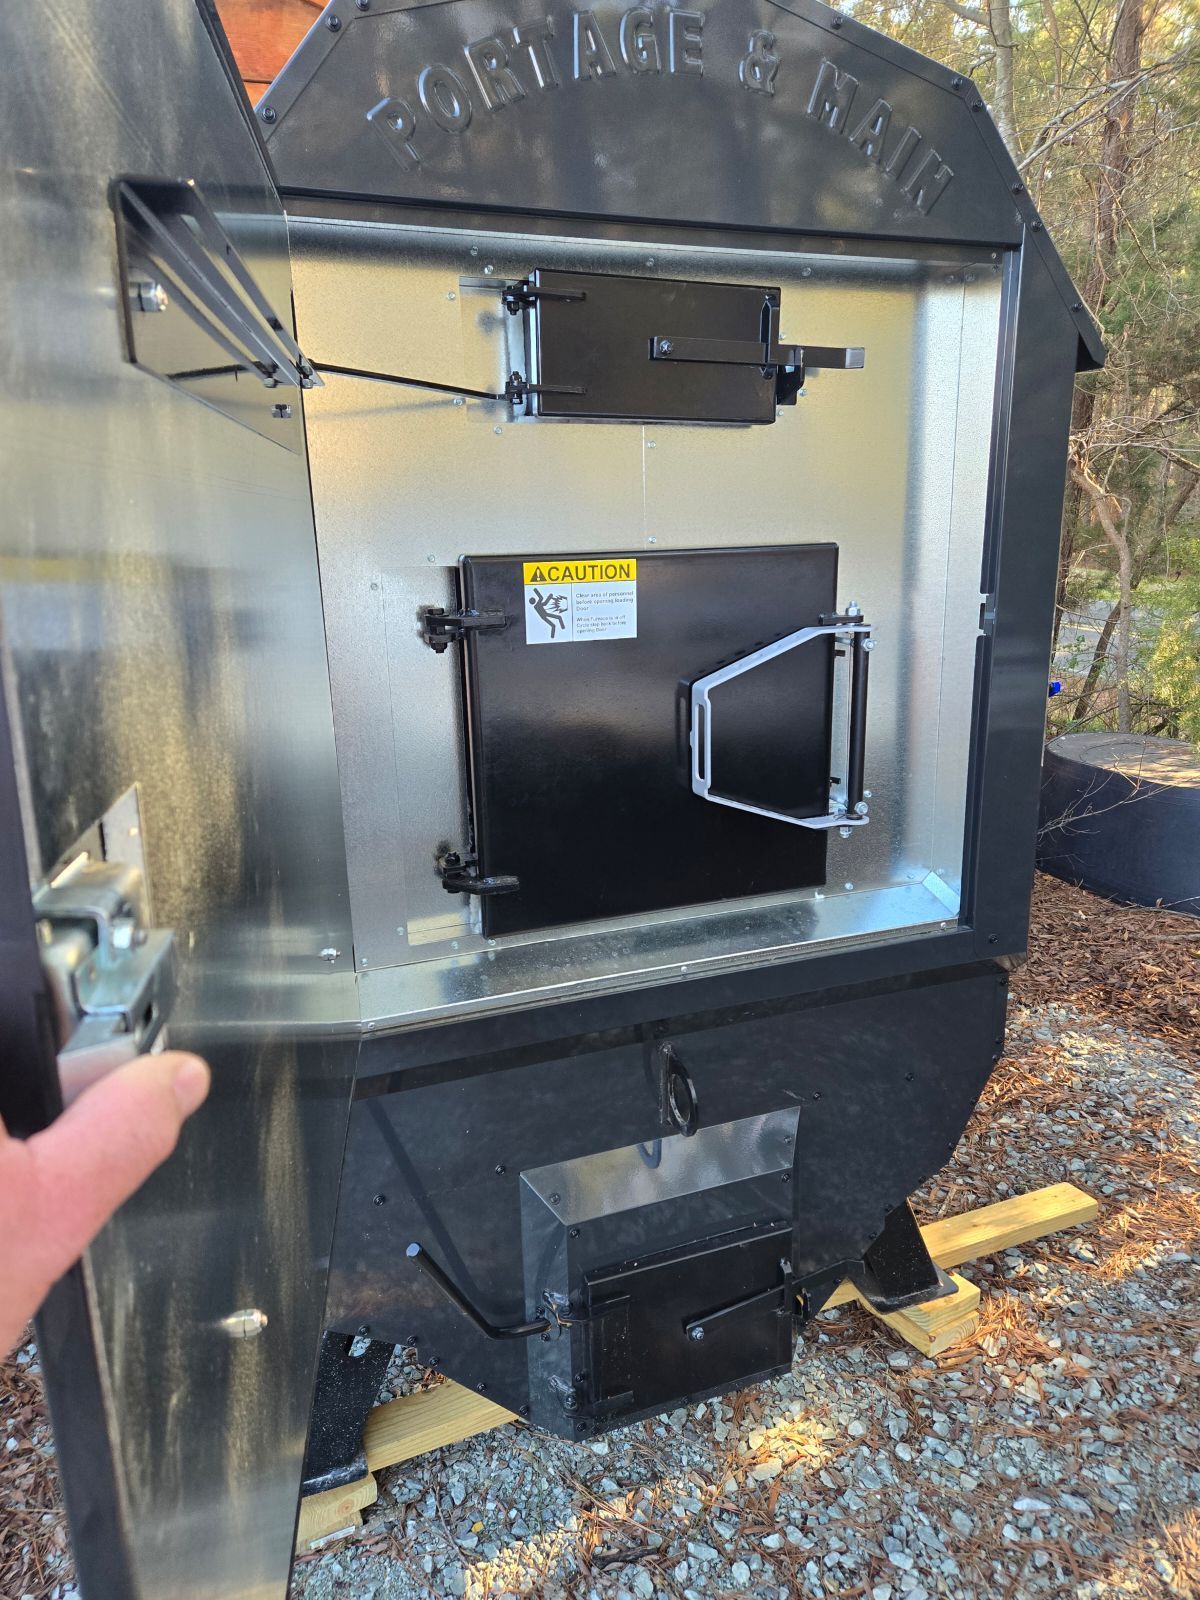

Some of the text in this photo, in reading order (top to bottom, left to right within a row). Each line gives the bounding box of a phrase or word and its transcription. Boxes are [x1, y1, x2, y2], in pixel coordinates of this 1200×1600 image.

[366, 6, 955, 216] PORTAGE & MAIN
[548, 563, 630, 581] CAUTION
